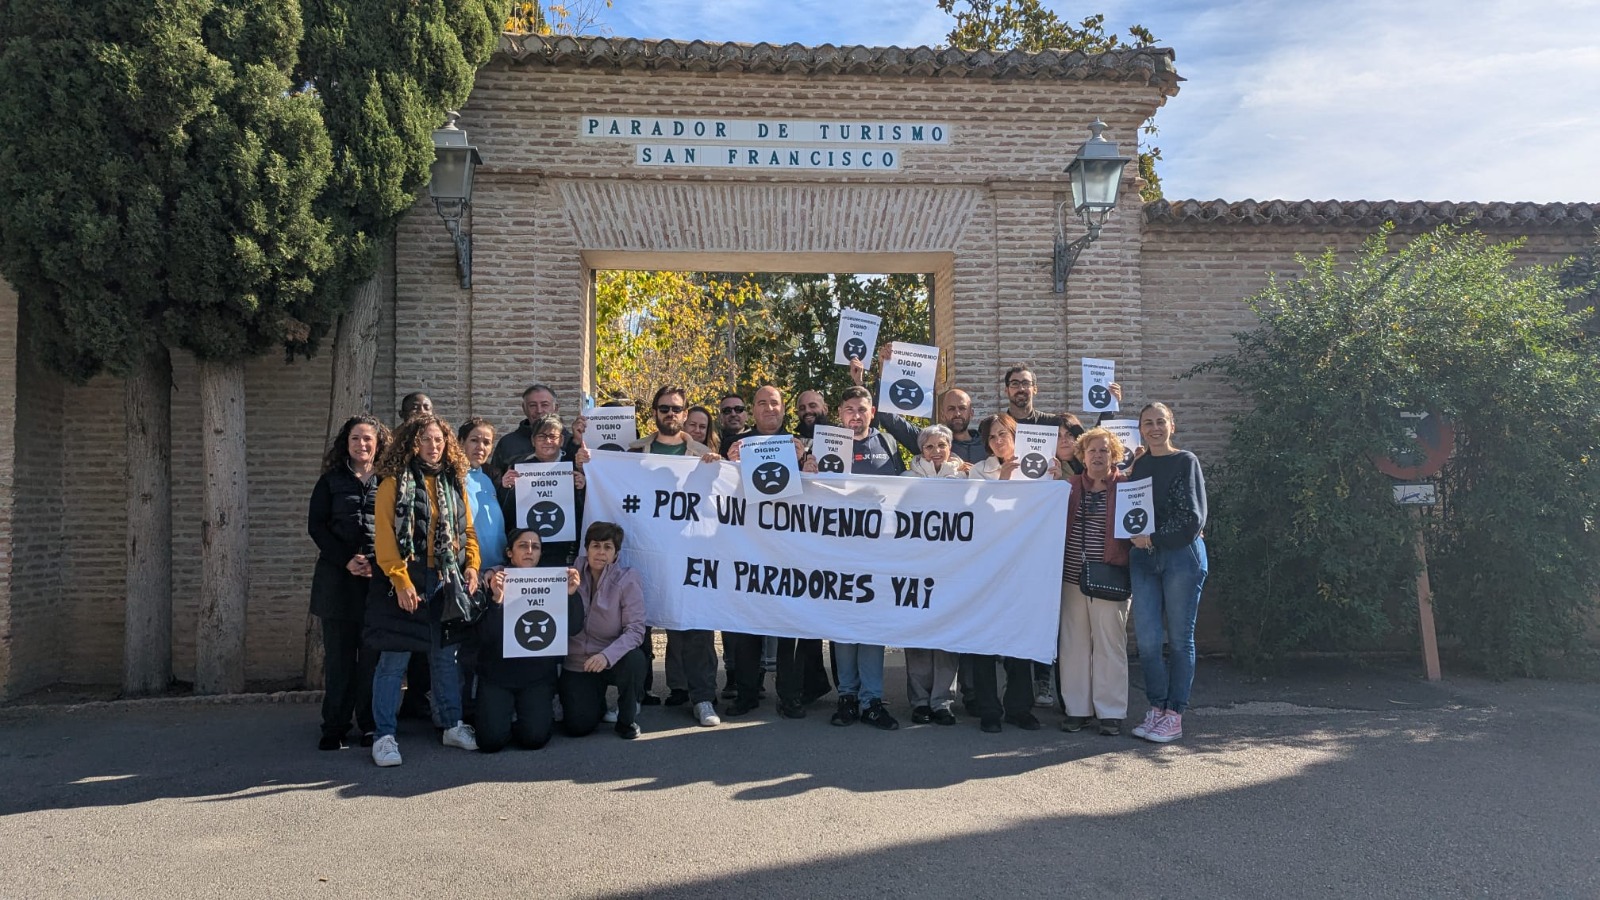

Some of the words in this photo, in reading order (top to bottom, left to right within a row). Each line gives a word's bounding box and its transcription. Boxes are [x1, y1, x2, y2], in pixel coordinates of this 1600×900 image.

[588, 119, 727, 138] PARADOR
[758, 123, 789, 139] DE
[820, 124, 944, 142] TURISMO
[641, 147, 696, 164] SAN
[728, 149, 894, 167] FRANCISCO
[898, 359, 922, 368] DIGNO
[902, 369, 916, 377] YA!!
[622, 494, 641, 513] #
[653, 490, 701, 522] POR
[716, 495, 746, 526] UN
[758, 500, 883, 539] CONVENIO
[894, 510, 974, 542] DIGNO
[505, 576, 568, 584] #PORUNCONVENIO
[683, 557, 720, 590] EN
[734, 560, 875, 603] PARADORES
[521, 587, 551, 595] DIGNO
[527, 598, 545, 607] YA!!
